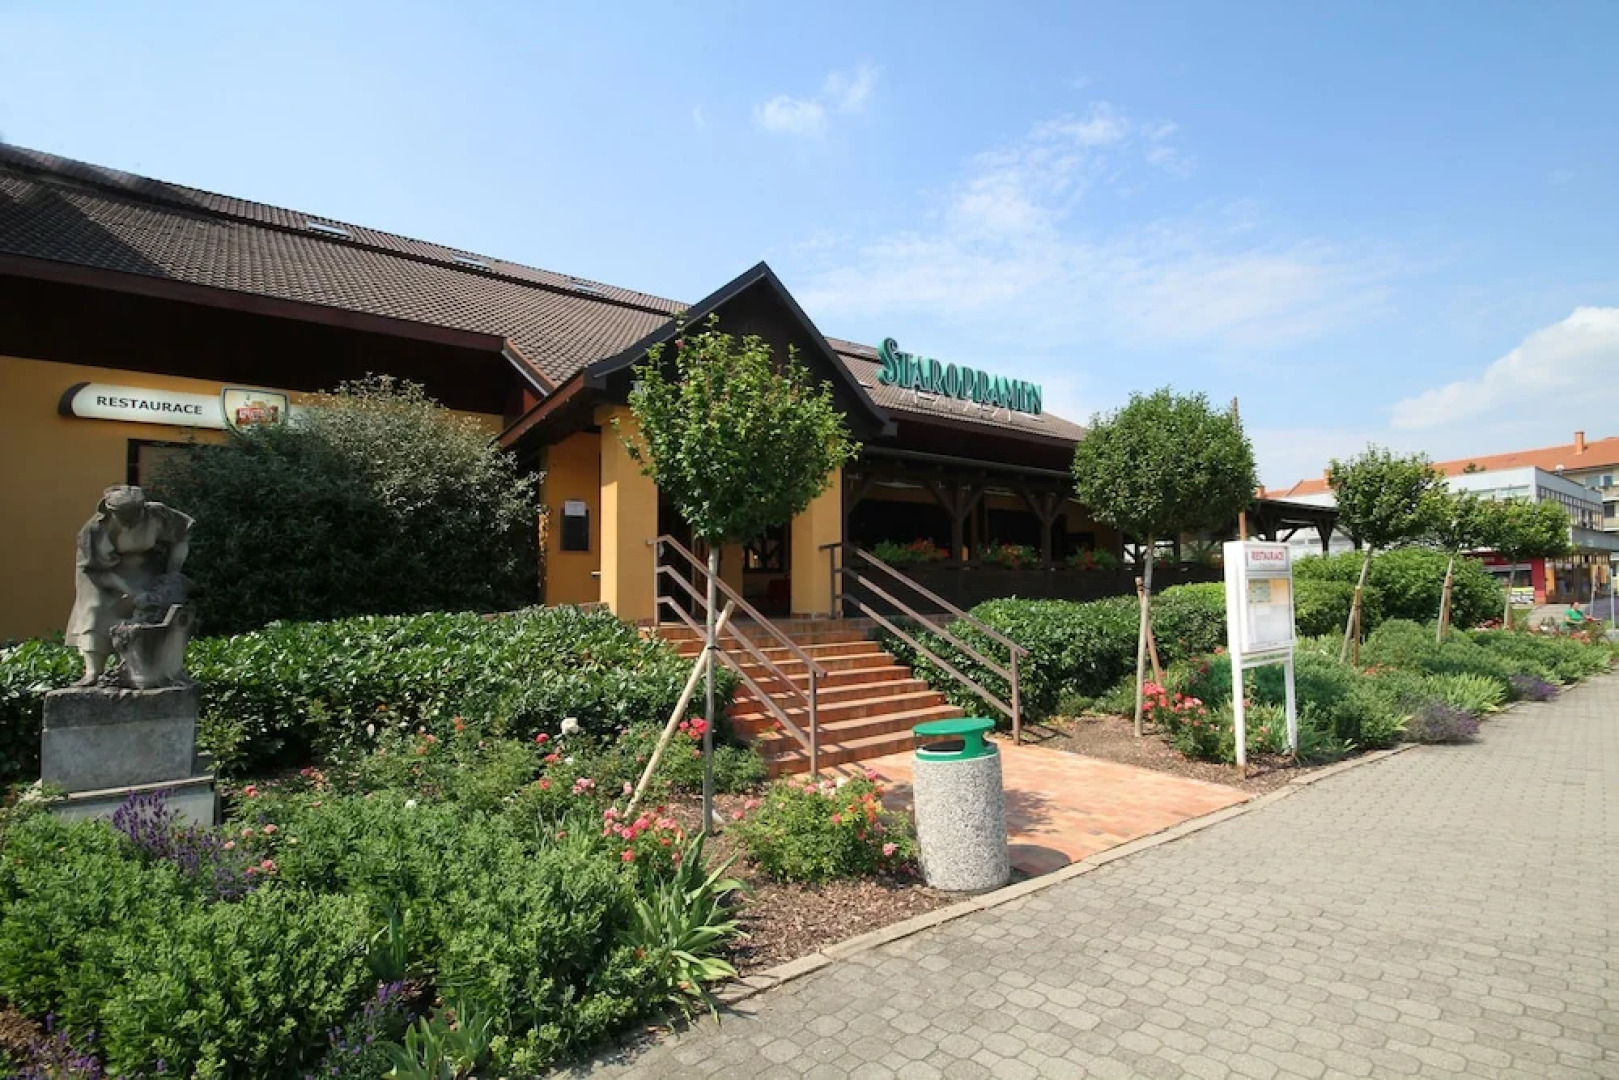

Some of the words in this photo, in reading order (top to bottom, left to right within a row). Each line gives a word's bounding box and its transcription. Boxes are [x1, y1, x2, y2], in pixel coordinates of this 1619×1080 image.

[876, 337, 1042, 414] STAROPRAMEN
[96, 396, 203, 415] RESTAURACE
[1251, 550, 1285, 561] RESTAURACE
